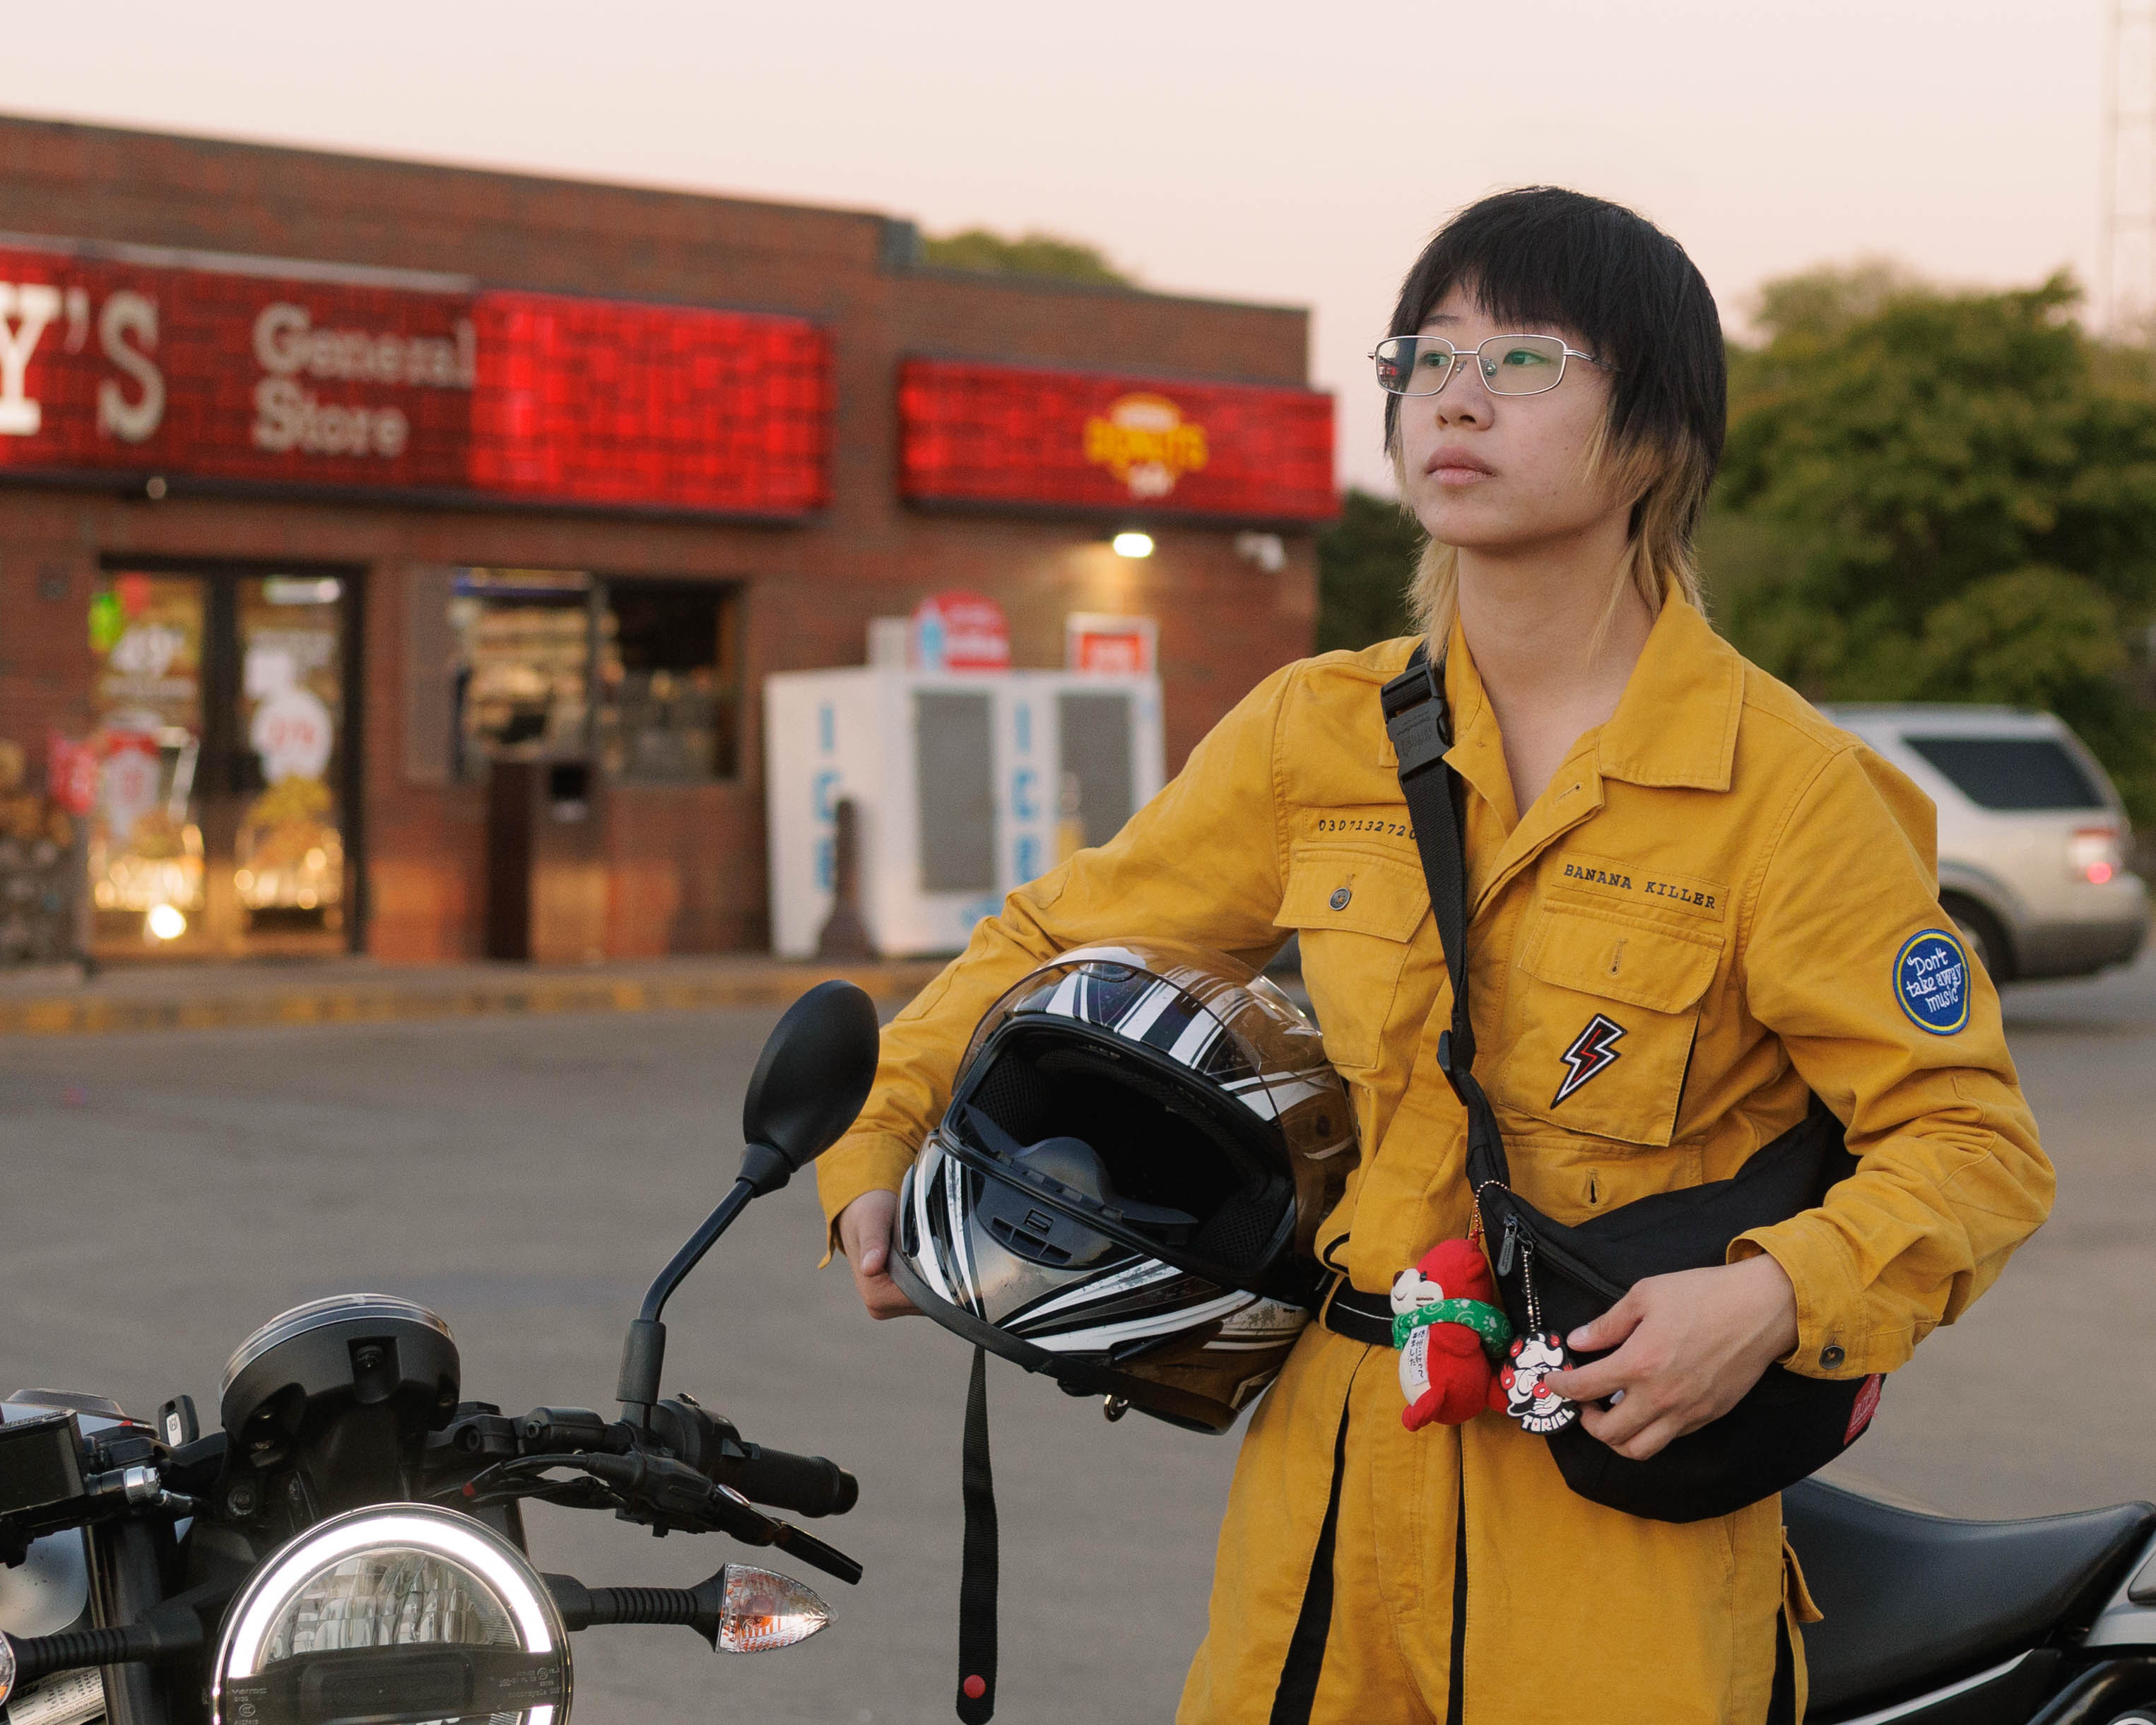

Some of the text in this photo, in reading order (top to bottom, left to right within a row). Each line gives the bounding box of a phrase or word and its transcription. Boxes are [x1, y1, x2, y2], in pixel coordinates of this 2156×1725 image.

[252, 302, 478, 389] General
[252, 375, 409, 457] Store
[1564, 864, 1716, 909] BANANA KILLER
[1906, 962, 1962, 998] take away
[1521, 1408, 1576, 1432] TORIEL
